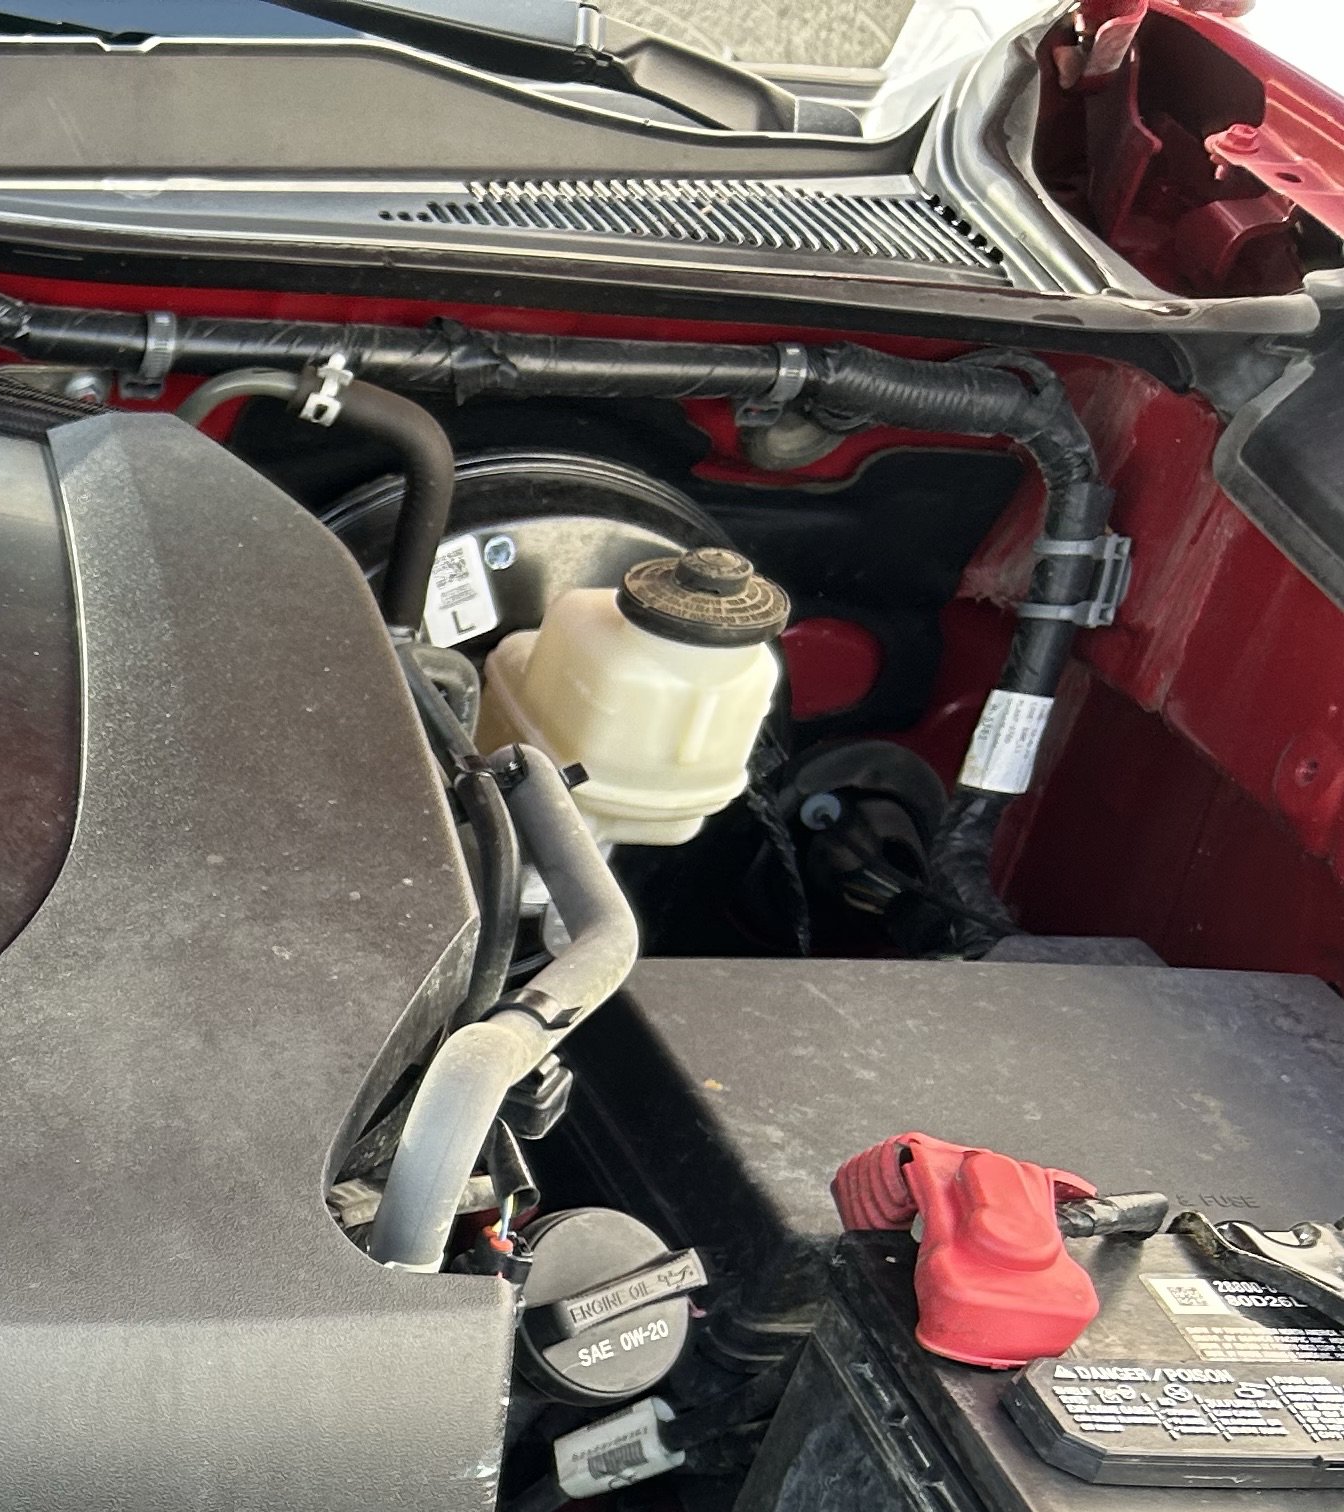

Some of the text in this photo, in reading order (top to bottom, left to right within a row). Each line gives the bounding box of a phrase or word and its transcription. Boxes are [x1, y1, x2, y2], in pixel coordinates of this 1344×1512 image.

[452, 610, 477, 635] L
[568, 1289, 623, 1324] ENGINE
[578, 1319, 669, 1367] SAE 0W-20
